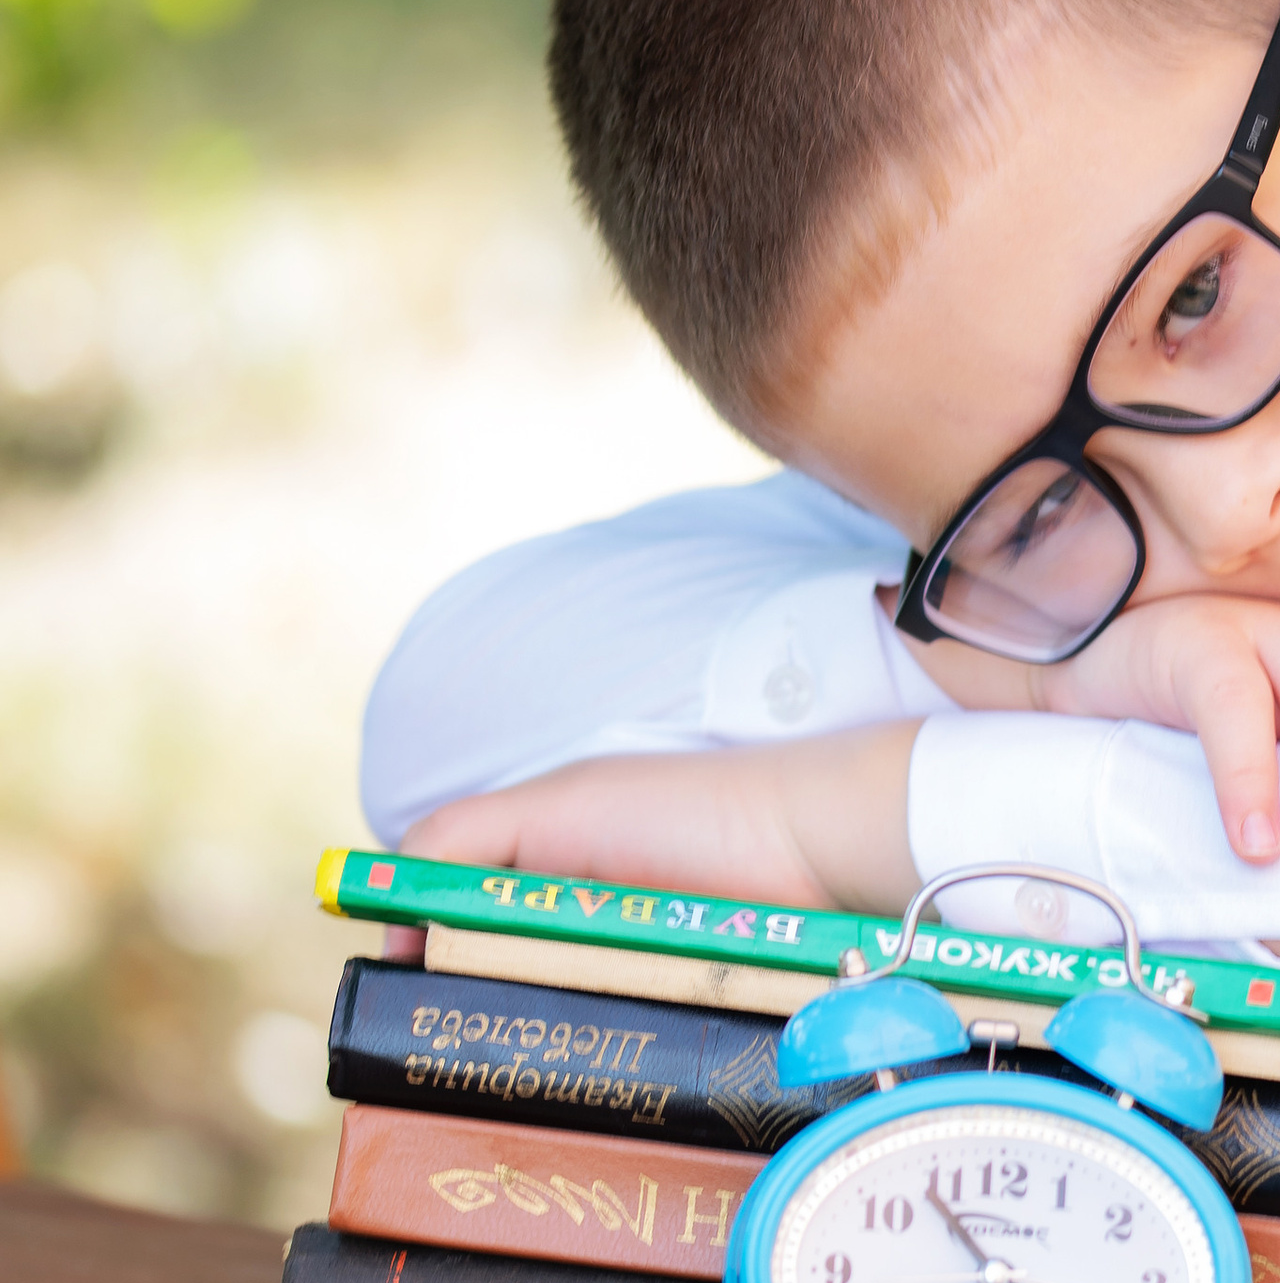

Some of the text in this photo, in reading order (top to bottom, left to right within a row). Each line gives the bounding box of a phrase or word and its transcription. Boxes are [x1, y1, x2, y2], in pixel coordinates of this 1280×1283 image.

[481, 875, 806, 944] БУКВАРЬ
[875, 928, 1080, 982] ЖУКОВА
[405, 1051, 679, 1126] Екатерина
[979, 1159, 1029, 1199] 12
[1053, 1173, 1070, 1211] 1
[862, 1193, 914, 1234] 10
[1104, 1203, 1133, 1244] 2
